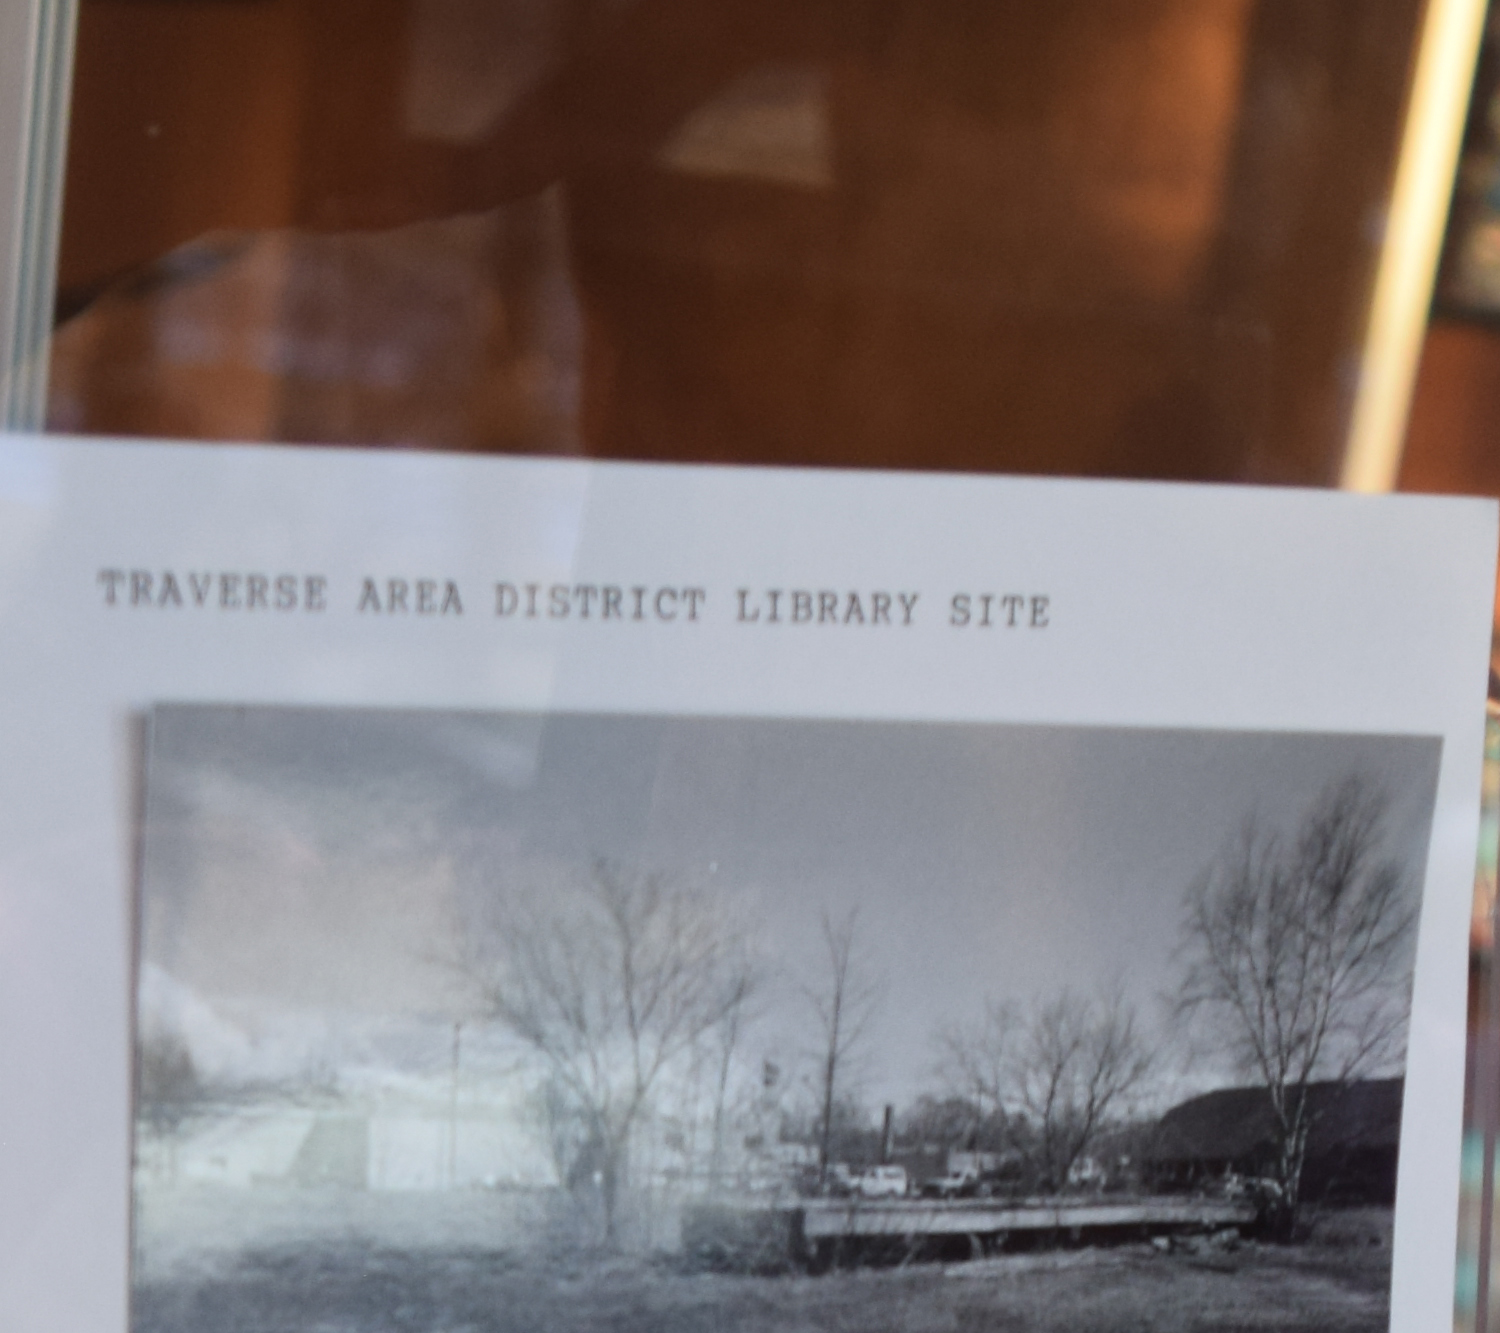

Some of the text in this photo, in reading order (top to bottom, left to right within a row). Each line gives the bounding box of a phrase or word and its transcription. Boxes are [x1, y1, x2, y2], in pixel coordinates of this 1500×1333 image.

[98, 568, 1053, 630] TRAVERSE AREA DISTRICT LIBRARY SITE
